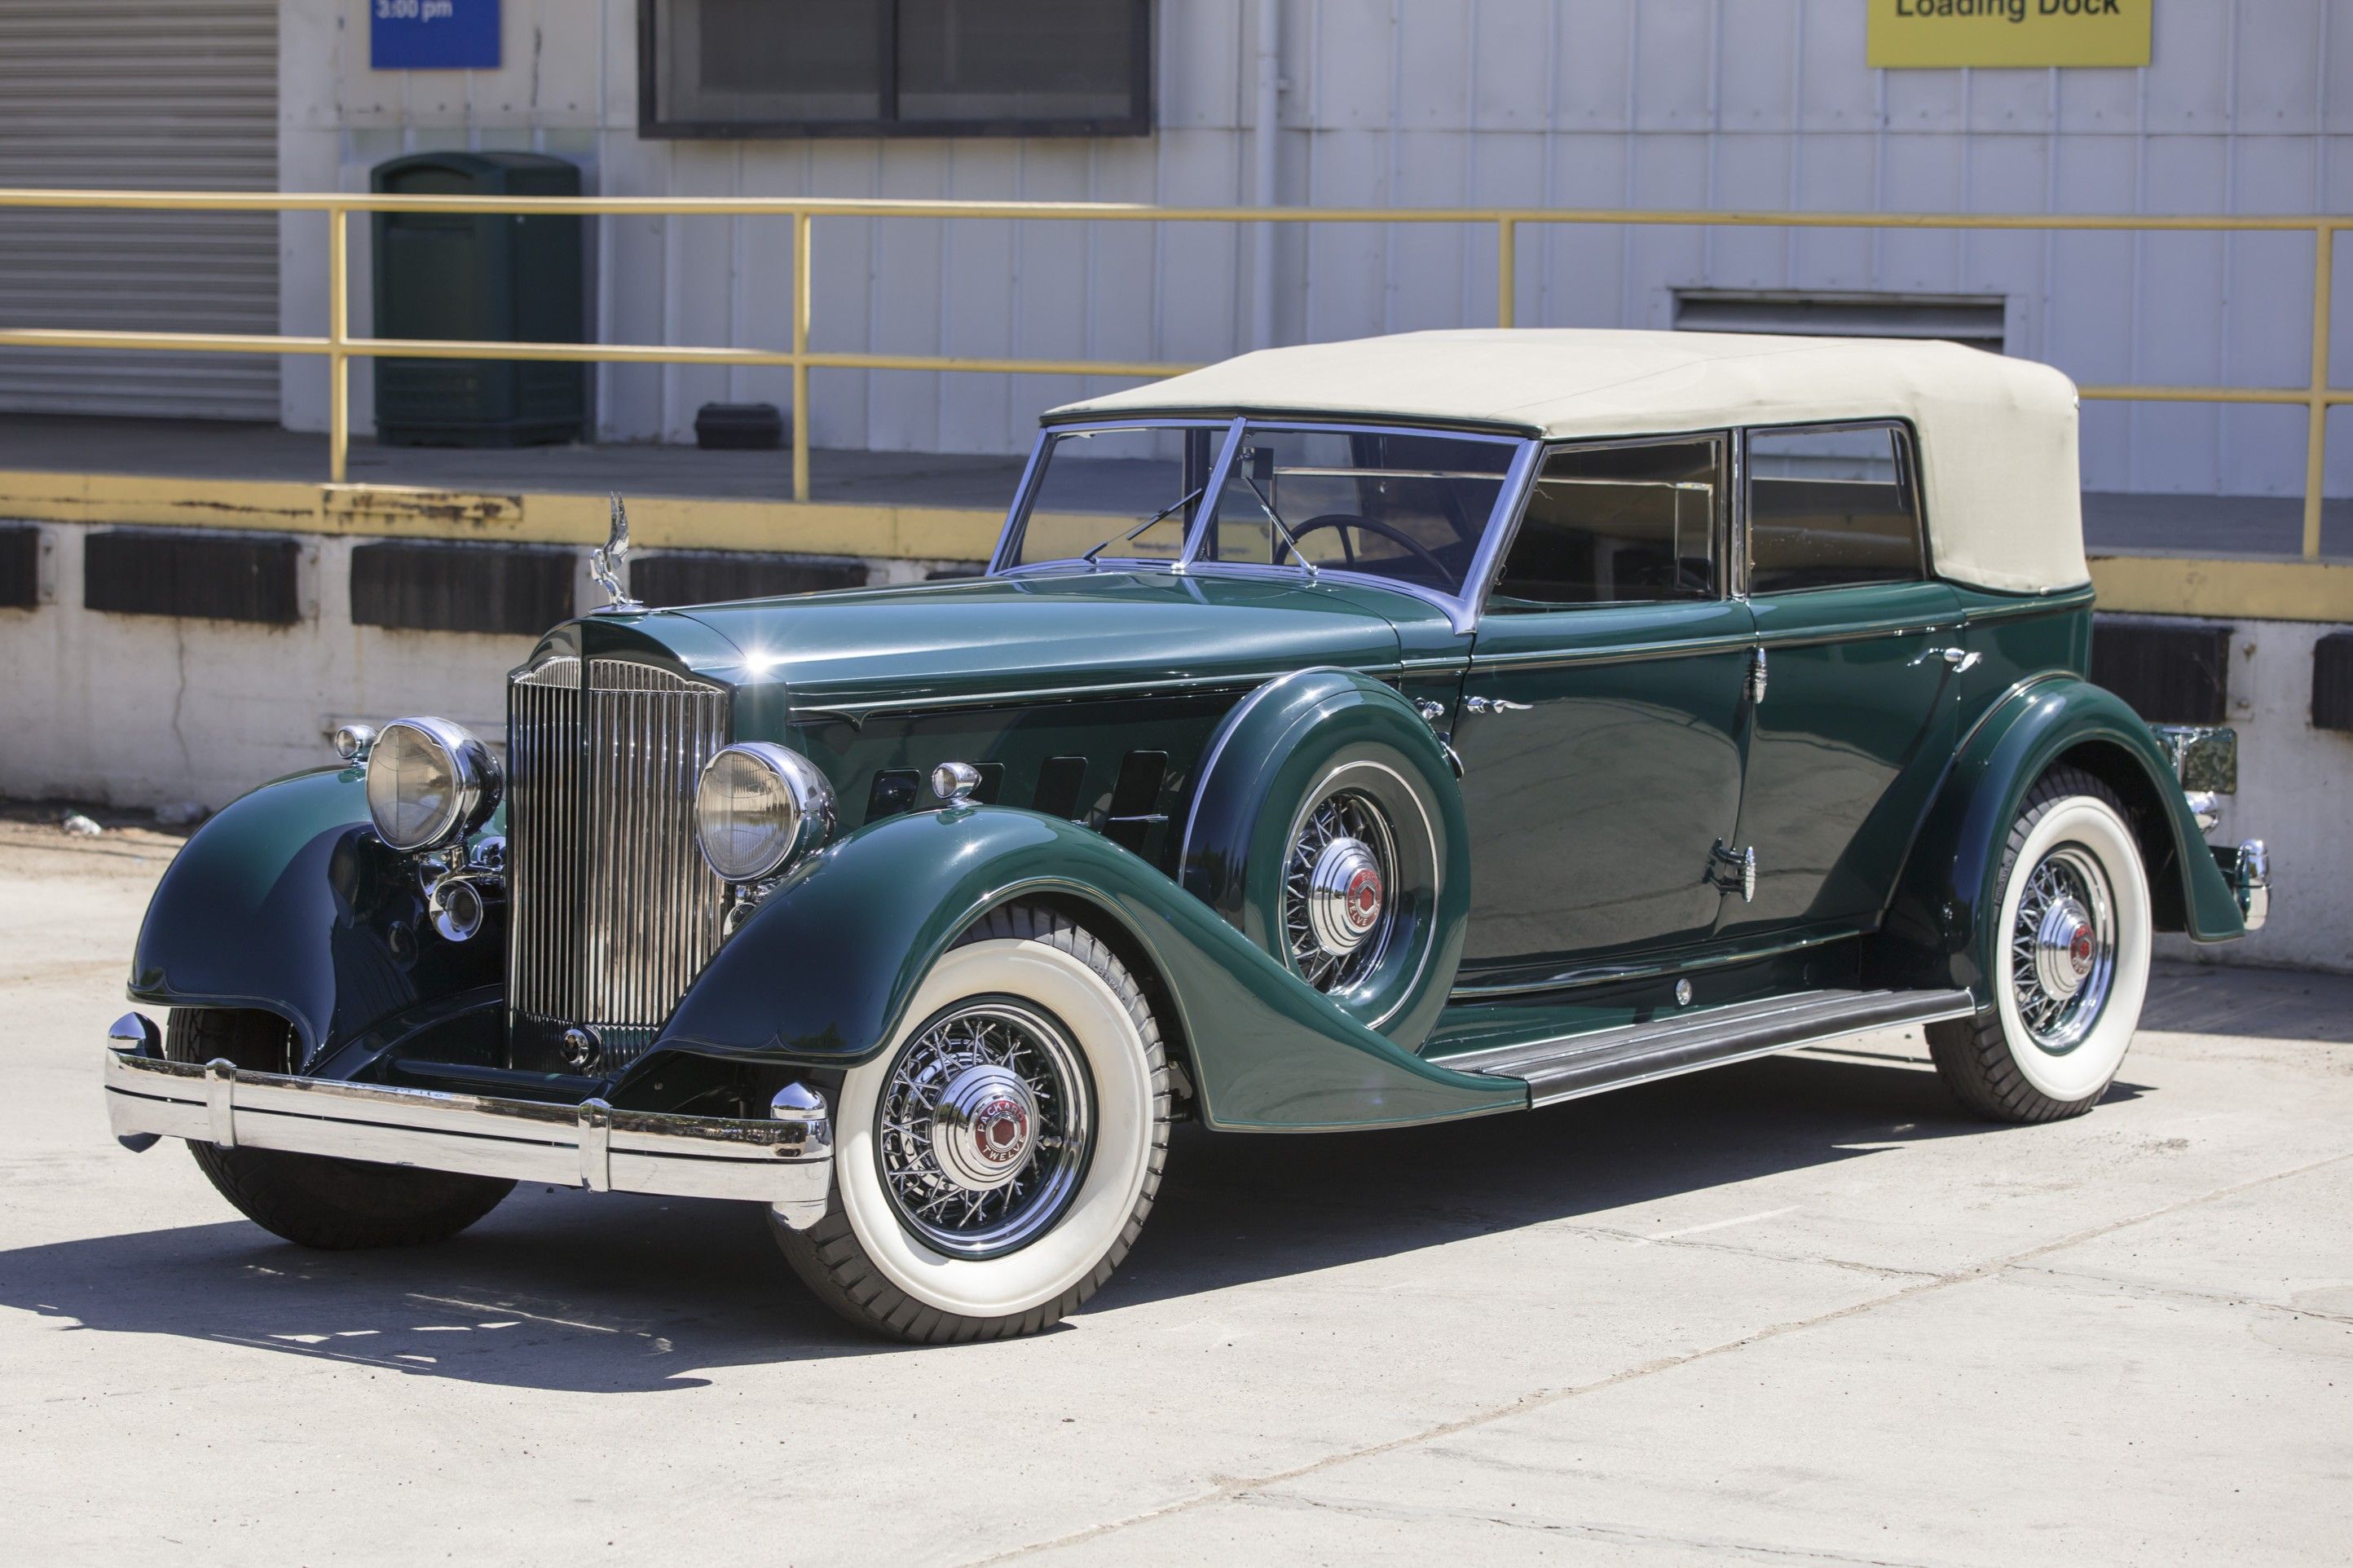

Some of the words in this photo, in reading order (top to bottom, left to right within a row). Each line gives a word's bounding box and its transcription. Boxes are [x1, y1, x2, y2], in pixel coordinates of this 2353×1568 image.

[376, 0, 418, 19] 3:00
[421, 0, 453, 23] pm
[1896, 0, 2027, 23] Loading
[2039, 0, 2122, 15] Dock
[977, 1103, 1024, 1132] PACKARD
[982, 1134, 1026, 1161] TWELVE
